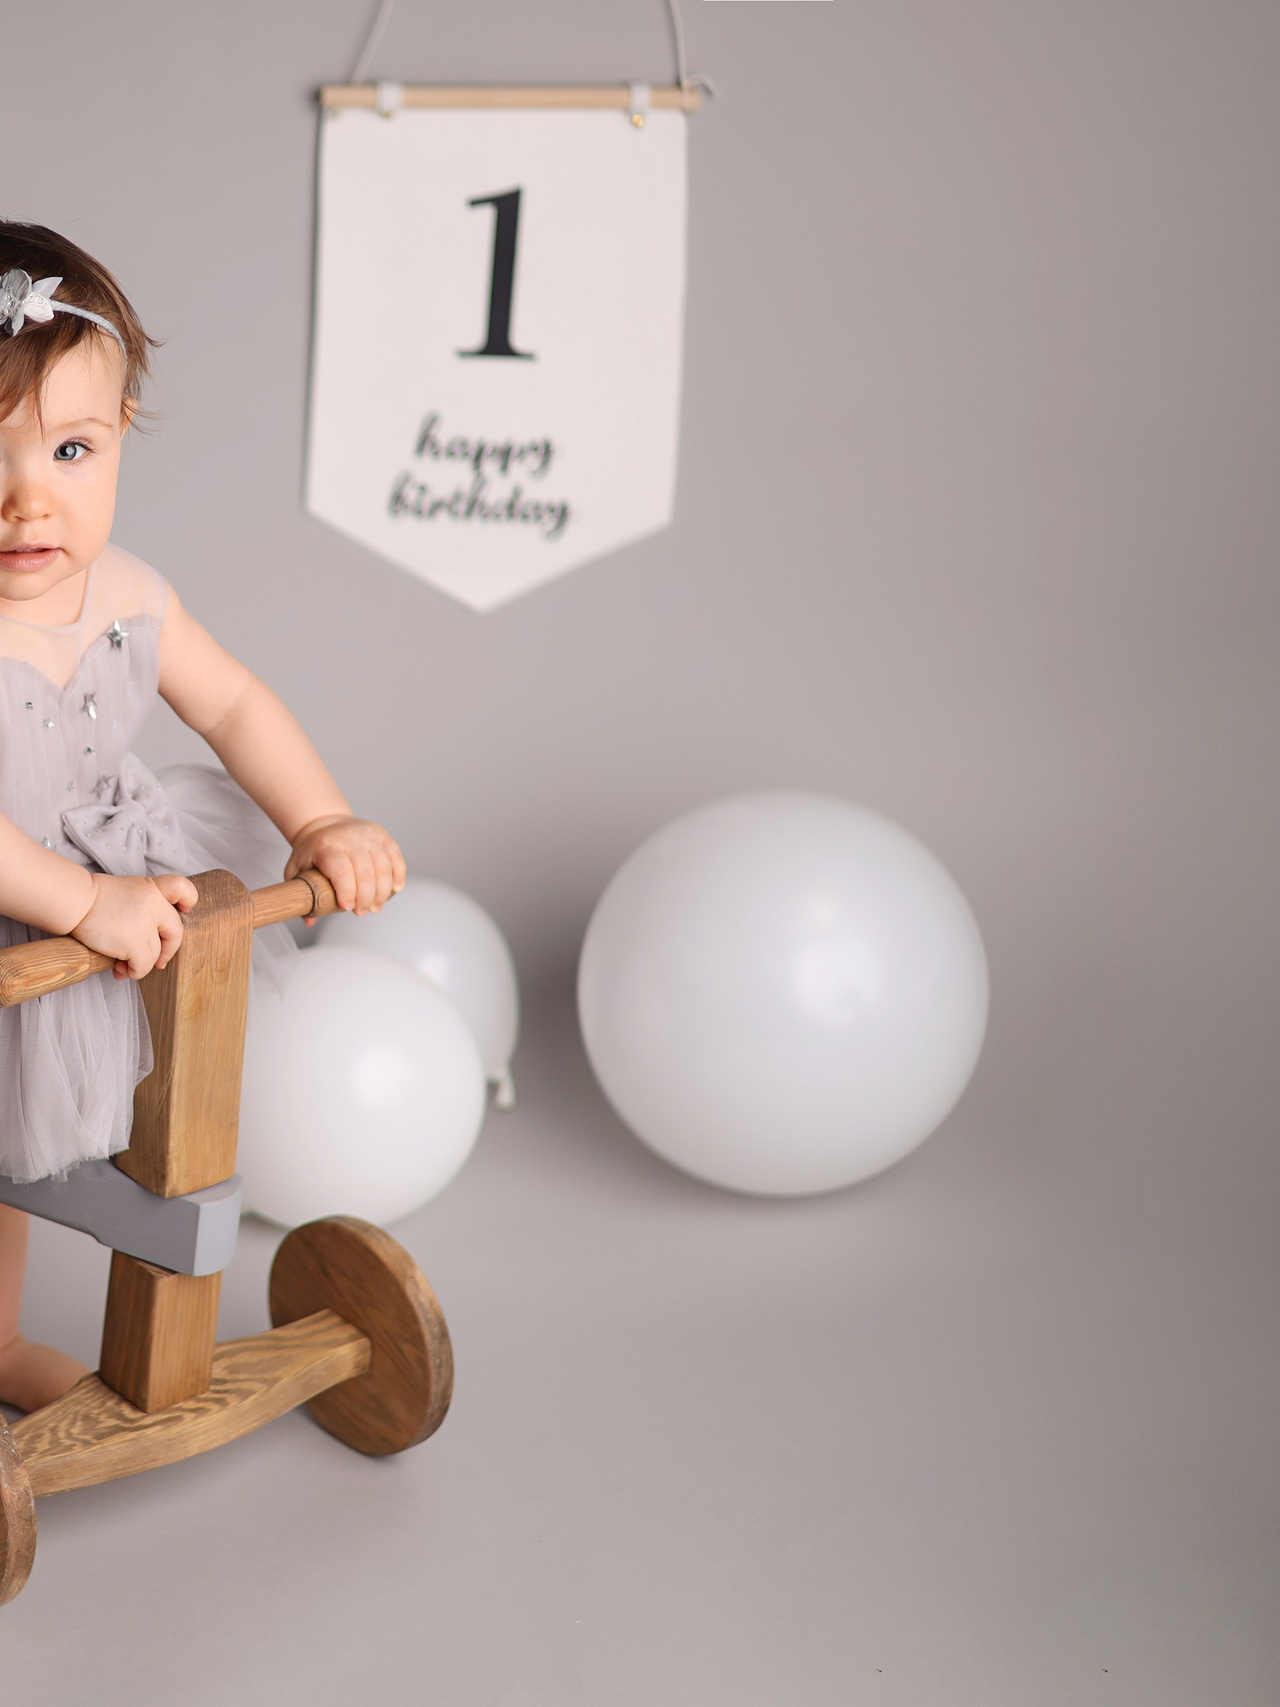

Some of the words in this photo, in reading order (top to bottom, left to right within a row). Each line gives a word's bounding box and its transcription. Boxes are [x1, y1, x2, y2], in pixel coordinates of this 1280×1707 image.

[457, 185, 536, 360] 1
[415, 413, 555, 476] happy
[388, 473, 571, 537] birthday
